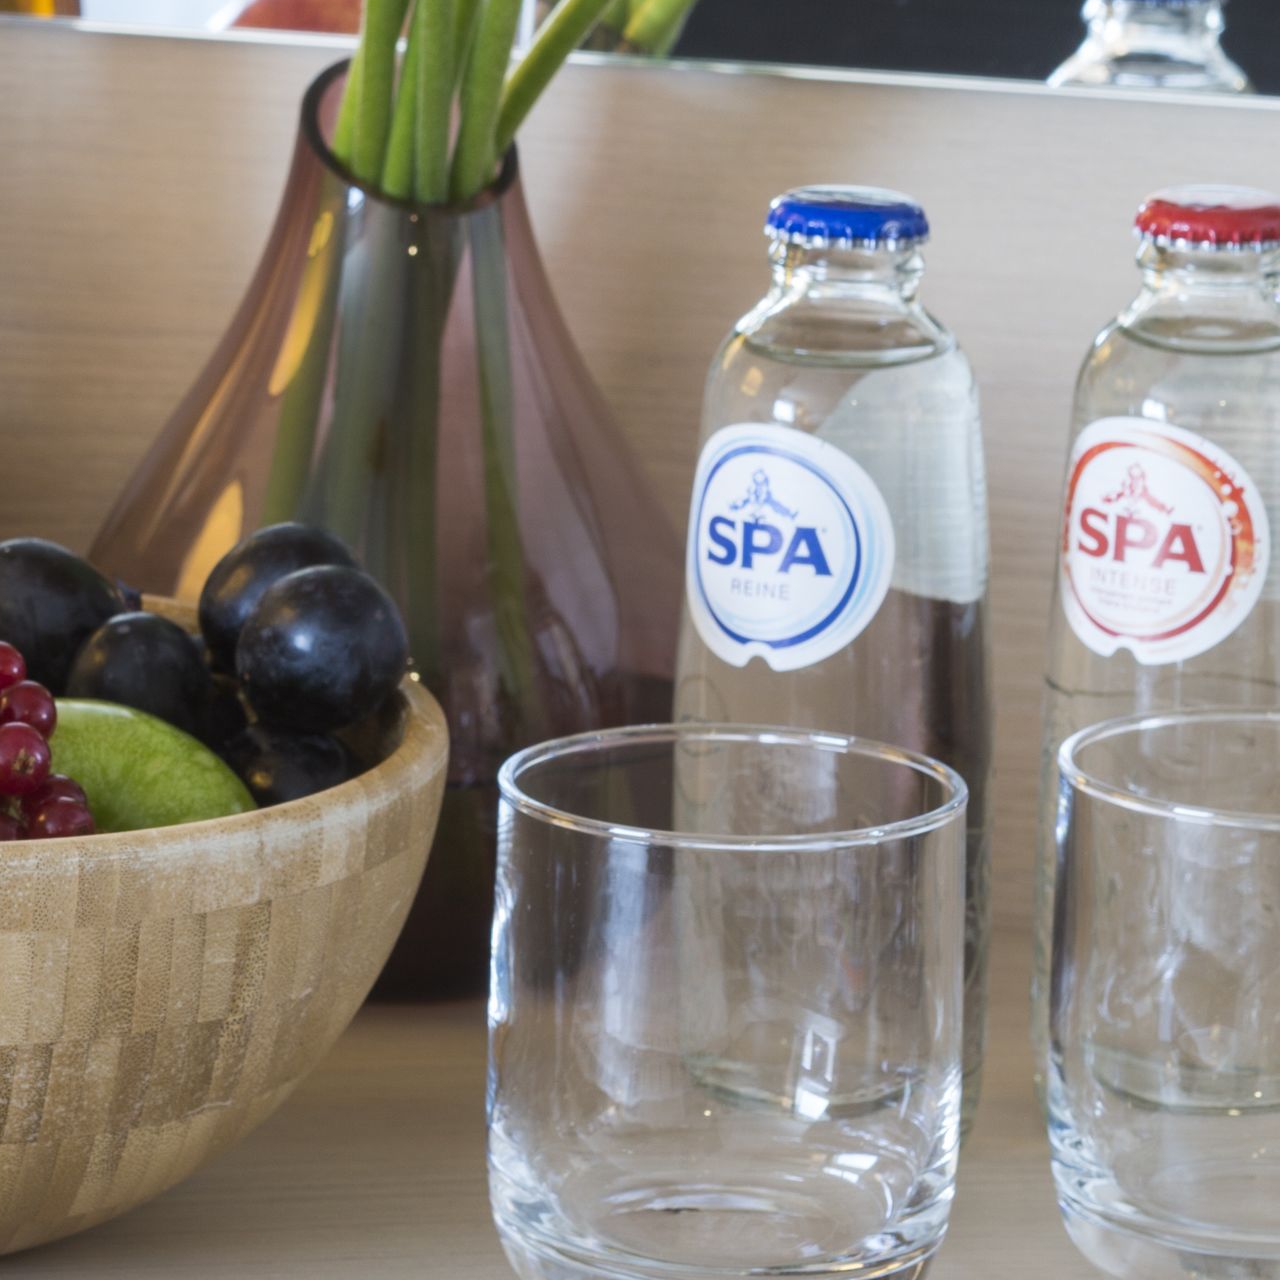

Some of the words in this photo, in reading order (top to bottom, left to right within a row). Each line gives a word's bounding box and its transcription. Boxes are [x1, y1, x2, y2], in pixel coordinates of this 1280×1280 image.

[707, 515, 834, 577] SPA
[1077, 507, 1207, 574] SPA
[730, 578, 790, 601] REINE
